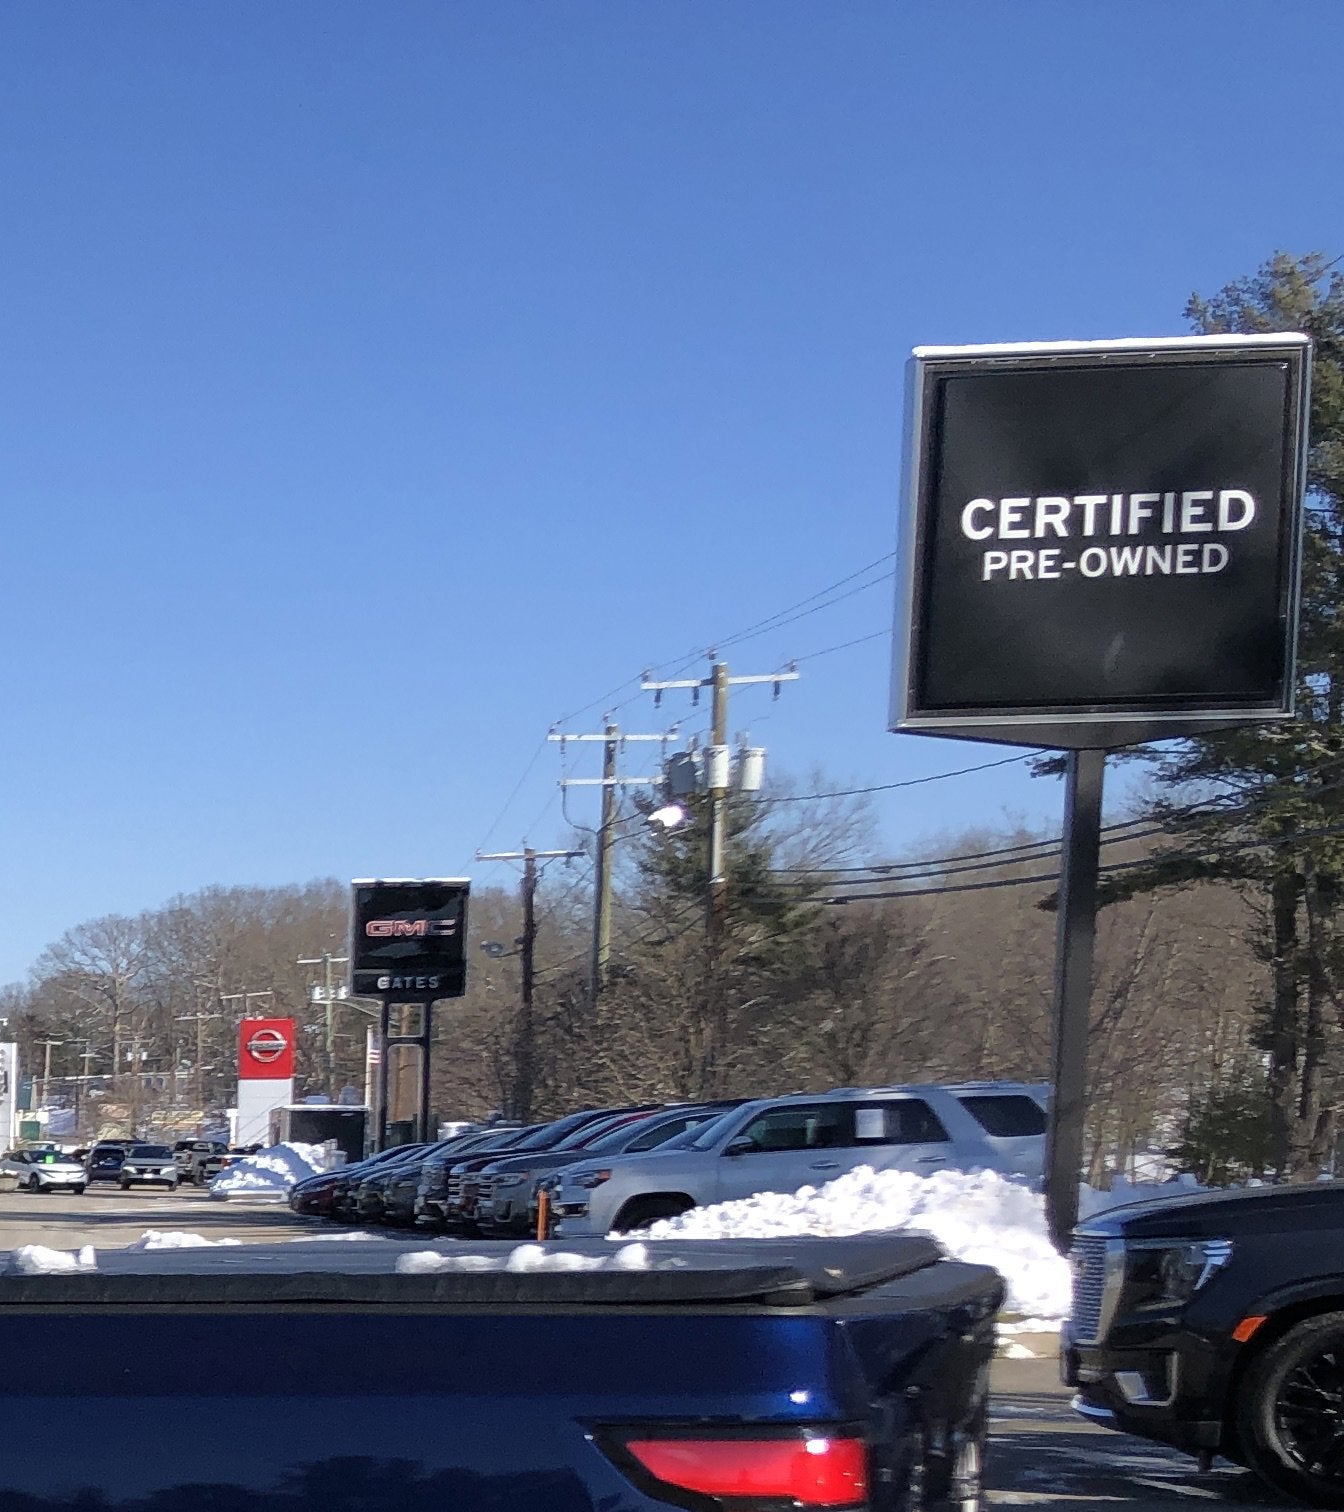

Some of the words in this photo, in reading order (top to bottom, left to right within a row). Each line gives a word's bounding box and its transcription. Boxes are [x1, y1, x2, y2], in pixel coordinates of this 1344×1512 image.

[960, 489, 1256, 541] CERTIFIED
[982, 543, 1230, 581] PRE-OWNED
[366, 919, 456, 937] GMC
[377, 975, 439, 990] GATES
